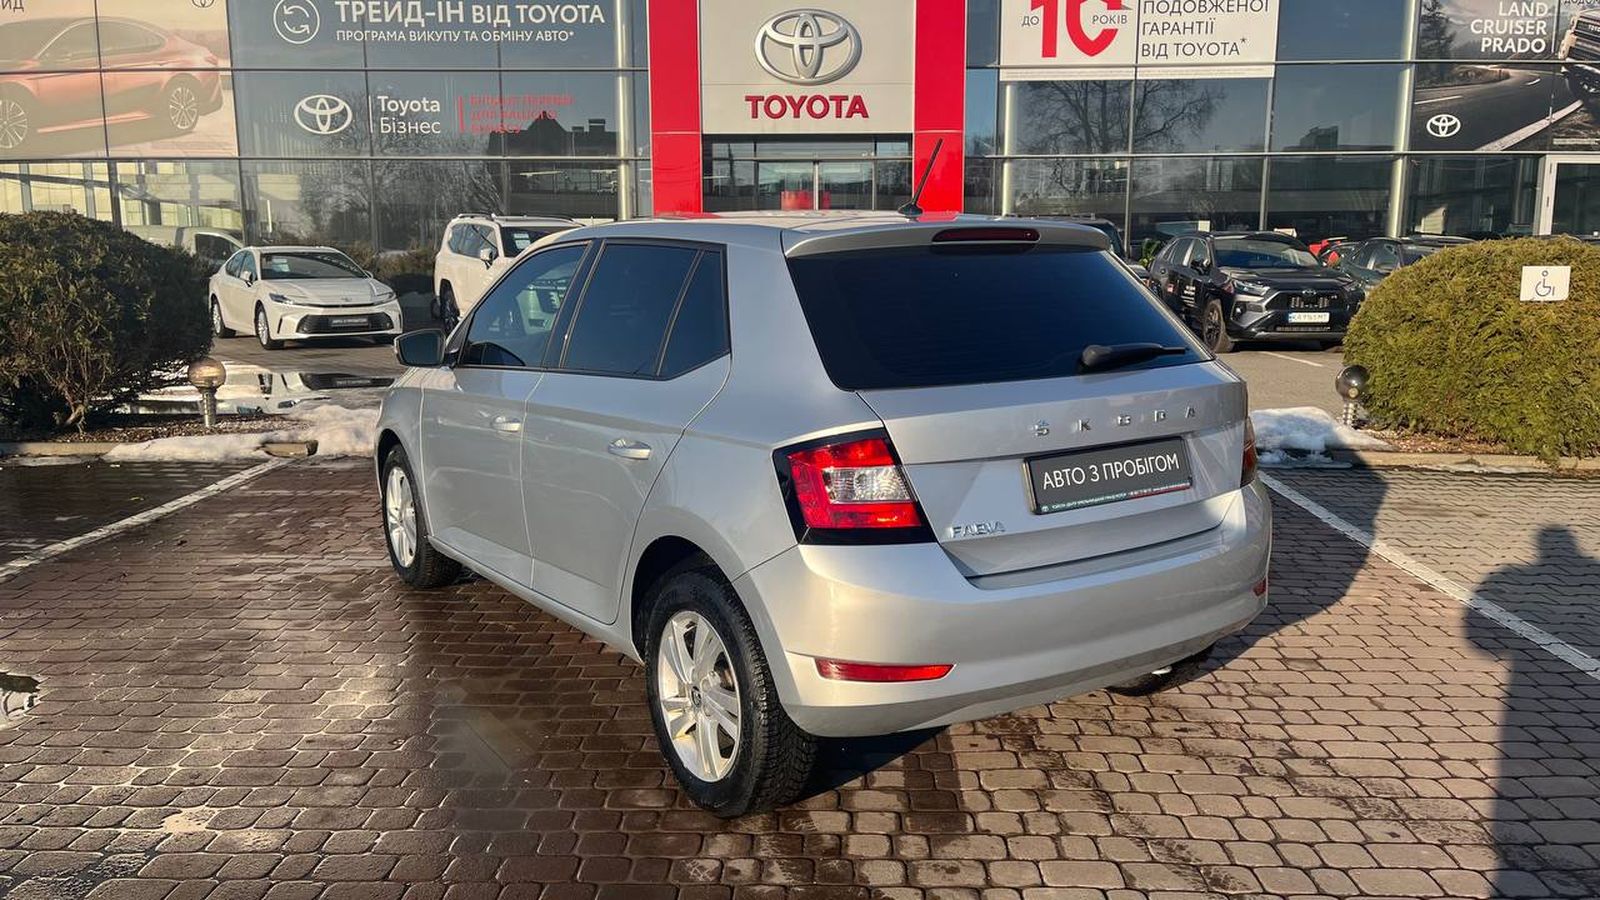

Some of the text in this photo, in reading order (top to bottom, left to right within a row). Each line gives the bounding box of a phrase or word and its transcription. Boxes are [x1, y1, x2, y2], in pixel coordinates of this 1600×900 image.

[471, 4, 511, 28] ВІД
[515, 4, 605, 24] TOYOTA
[1499, 2, 1548, 17] LAND
[1022, 15, 1040, 27] ДО
[1092, 14, 1128, 25] РОКІВ
[1142, 17, 1216, 36] ГАРАНТІЇ
[1470, 19, 1547, 35] CRUISER
[336, 30, 406, 41] ПРОГРАМА
[409, 30, 460, 42] ВИКУПУ
[463, 30, 479, 41] ТА
[481, 30, 533, 41] ОБМІНУ
[1141, 43, 1169, 59] ВІД
[1480, 37, 1546, 53] PRADO
[377, 95, 441, 116] Toyota
[744, 94, 869, 119] TOYOTA
[380, 117, 441, 134] Бізнес
[1043, 466, 1086, 490] АВТО
[1102, 452, 1180, 481] ПРОБІГОМ
